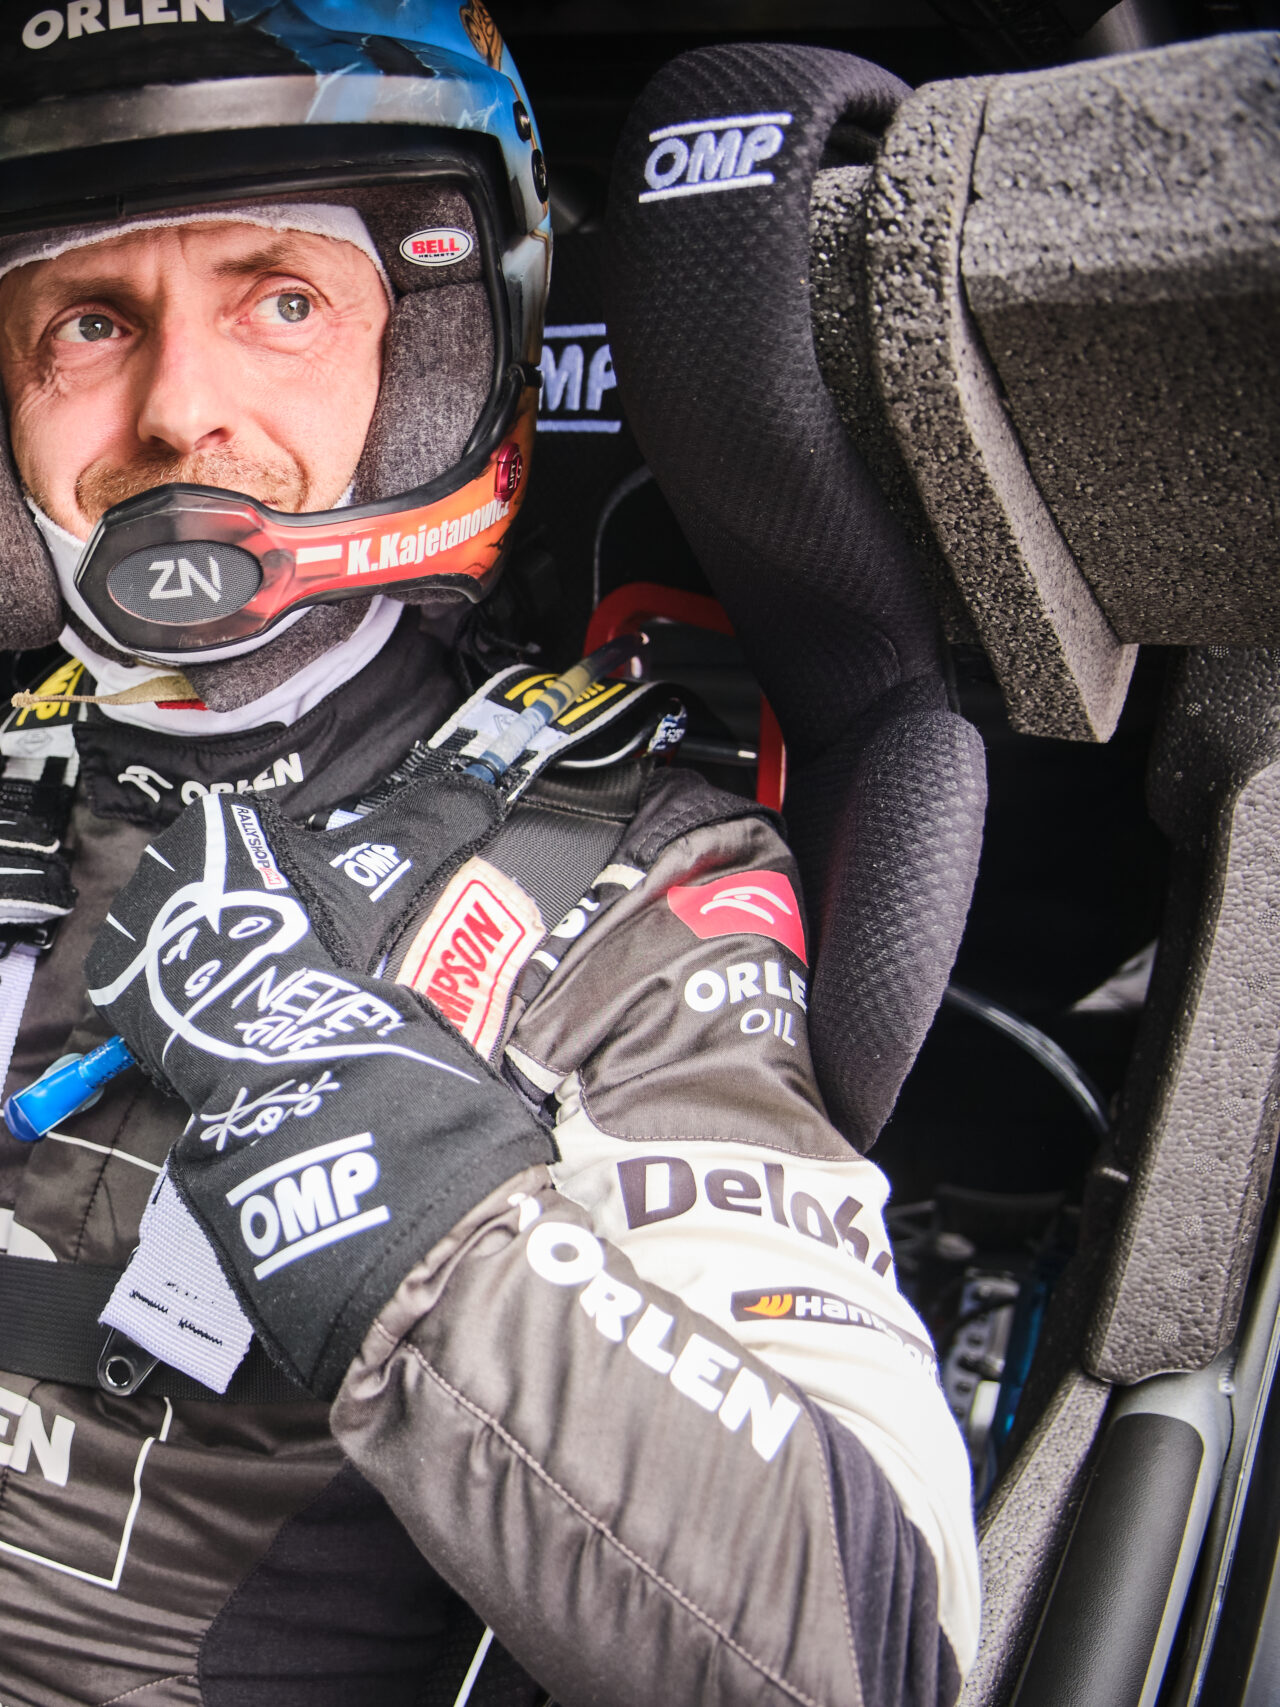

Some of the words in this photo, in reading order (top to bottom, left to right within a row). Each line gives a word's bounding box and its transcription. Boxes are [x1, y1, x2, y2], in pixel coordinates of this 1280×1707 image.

[22, 0, 226, 49] ORLEN
[644, 124, 785, 190] OMP
[412, 238, 460, 254] BELL
[539, 344, 618, 411] MP
[148, 556, 222, 602] ZN
[344, 844, 400, 887] OMP
[425, 900, 504, 1033] MPSON
[684, 961, 807, 1014] ORLE
[740, 1008, 796, 1047] OIL
[240, 1151, 381, 1258] OMP
[526, 1221, 802, 1463] ORLEN
